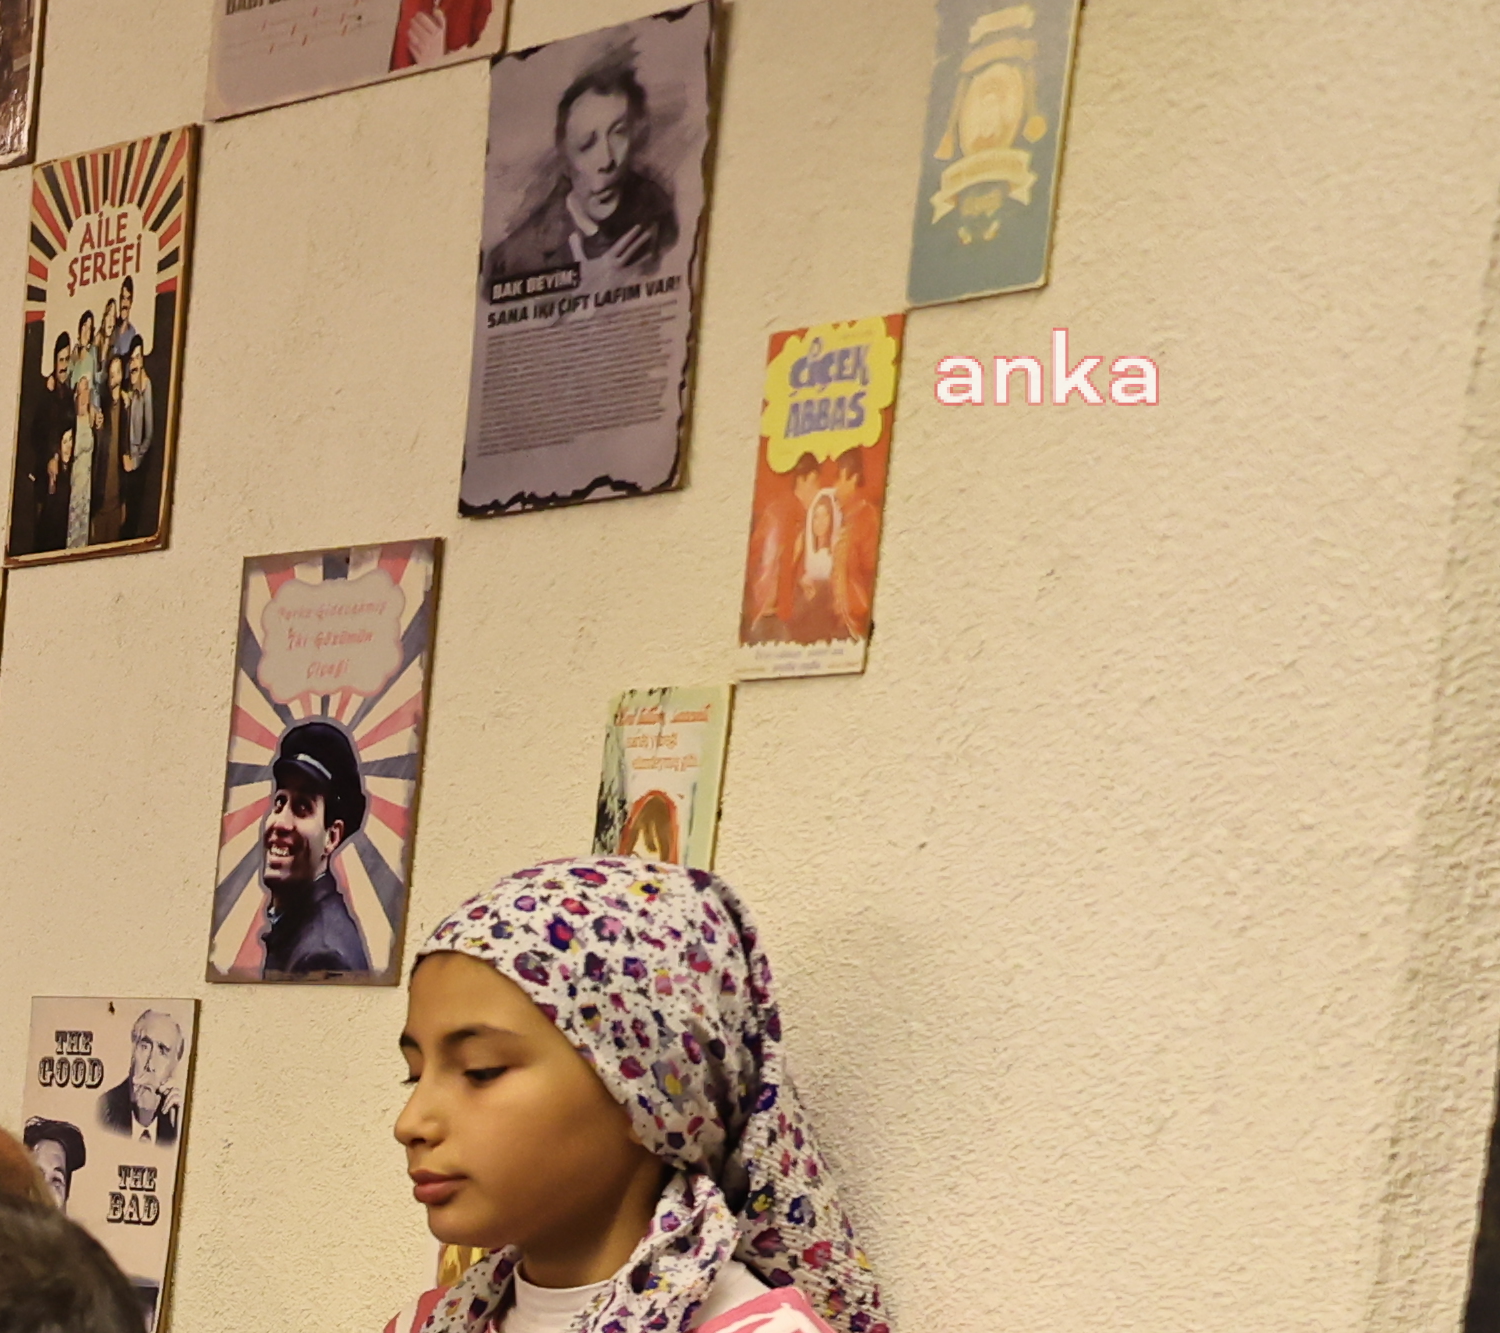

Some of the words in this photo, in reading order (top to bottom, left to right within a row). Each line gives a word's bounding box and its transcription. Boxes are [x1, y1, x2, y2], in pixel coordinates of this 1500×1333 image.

[79, 211, 128, 253] AİLE
[67, 233, 142, 297] ŞEREFİ
[487, 306, 529, 328] SANA
[784, 391, 867, 439] ABBAS
[54, 1030, 94, 1056] THE
[38, 1056, 105, 1089] GOOD
[118, 1165, 158, 1191] THE
[106, 1191, 160, 1226] BAD
